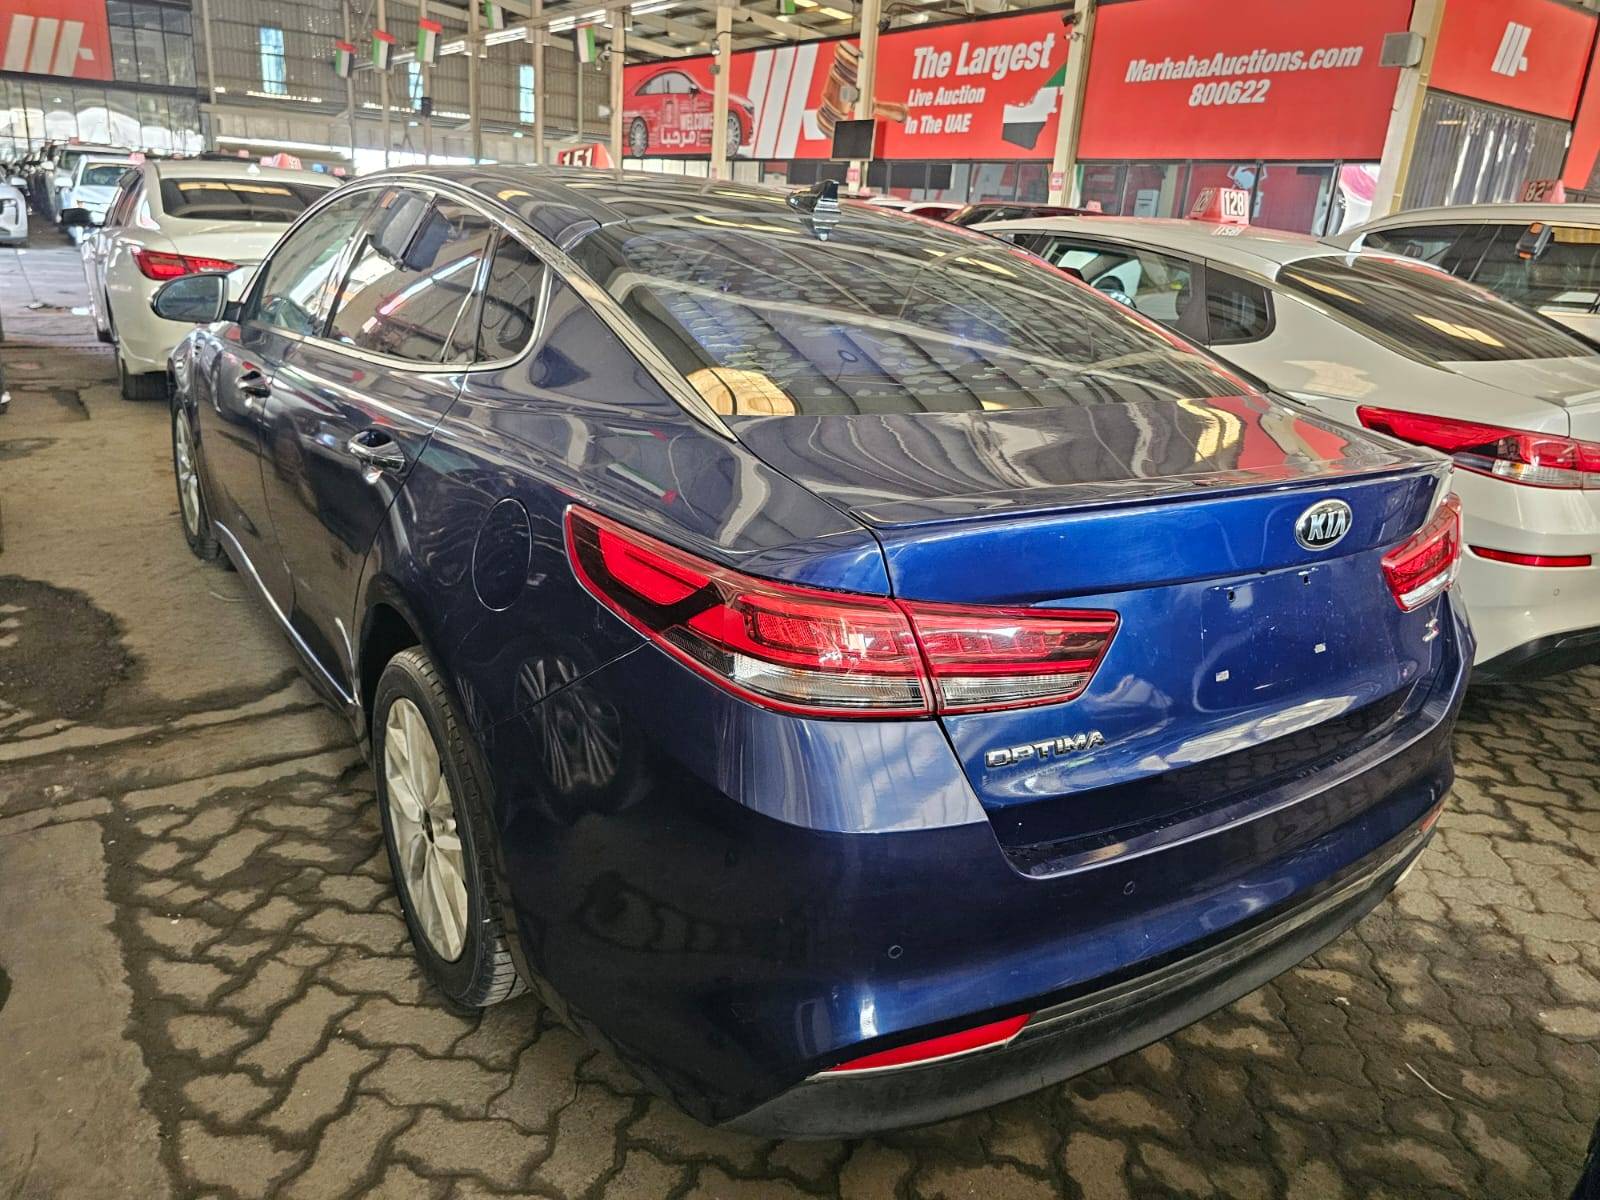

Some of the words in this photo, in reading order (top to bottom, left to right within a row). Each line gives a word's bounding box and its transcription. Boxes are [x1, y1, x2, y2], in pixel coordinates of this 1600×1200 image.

[912, 46, 952, 80] The
[955, 32, 1055, 81] Largest
[1124, 46, 1364, 83] MarhabaAuctions.com
[907, 88, 932, 107] Live
[934, 85, 986, 106] Auction
[1188, 79, 1271, 107] 800622
[660, 127, 696, 147] مرحبا
[904, 116, 918, 134] In
[920, 115, 942, 134] The
[944, 113, 972, 133] UAE
[1224, 191, 1245, 216] 128
[1307, 510, 1346, 541] KIA
[985, 730, 1105, 768] OPTIMA
